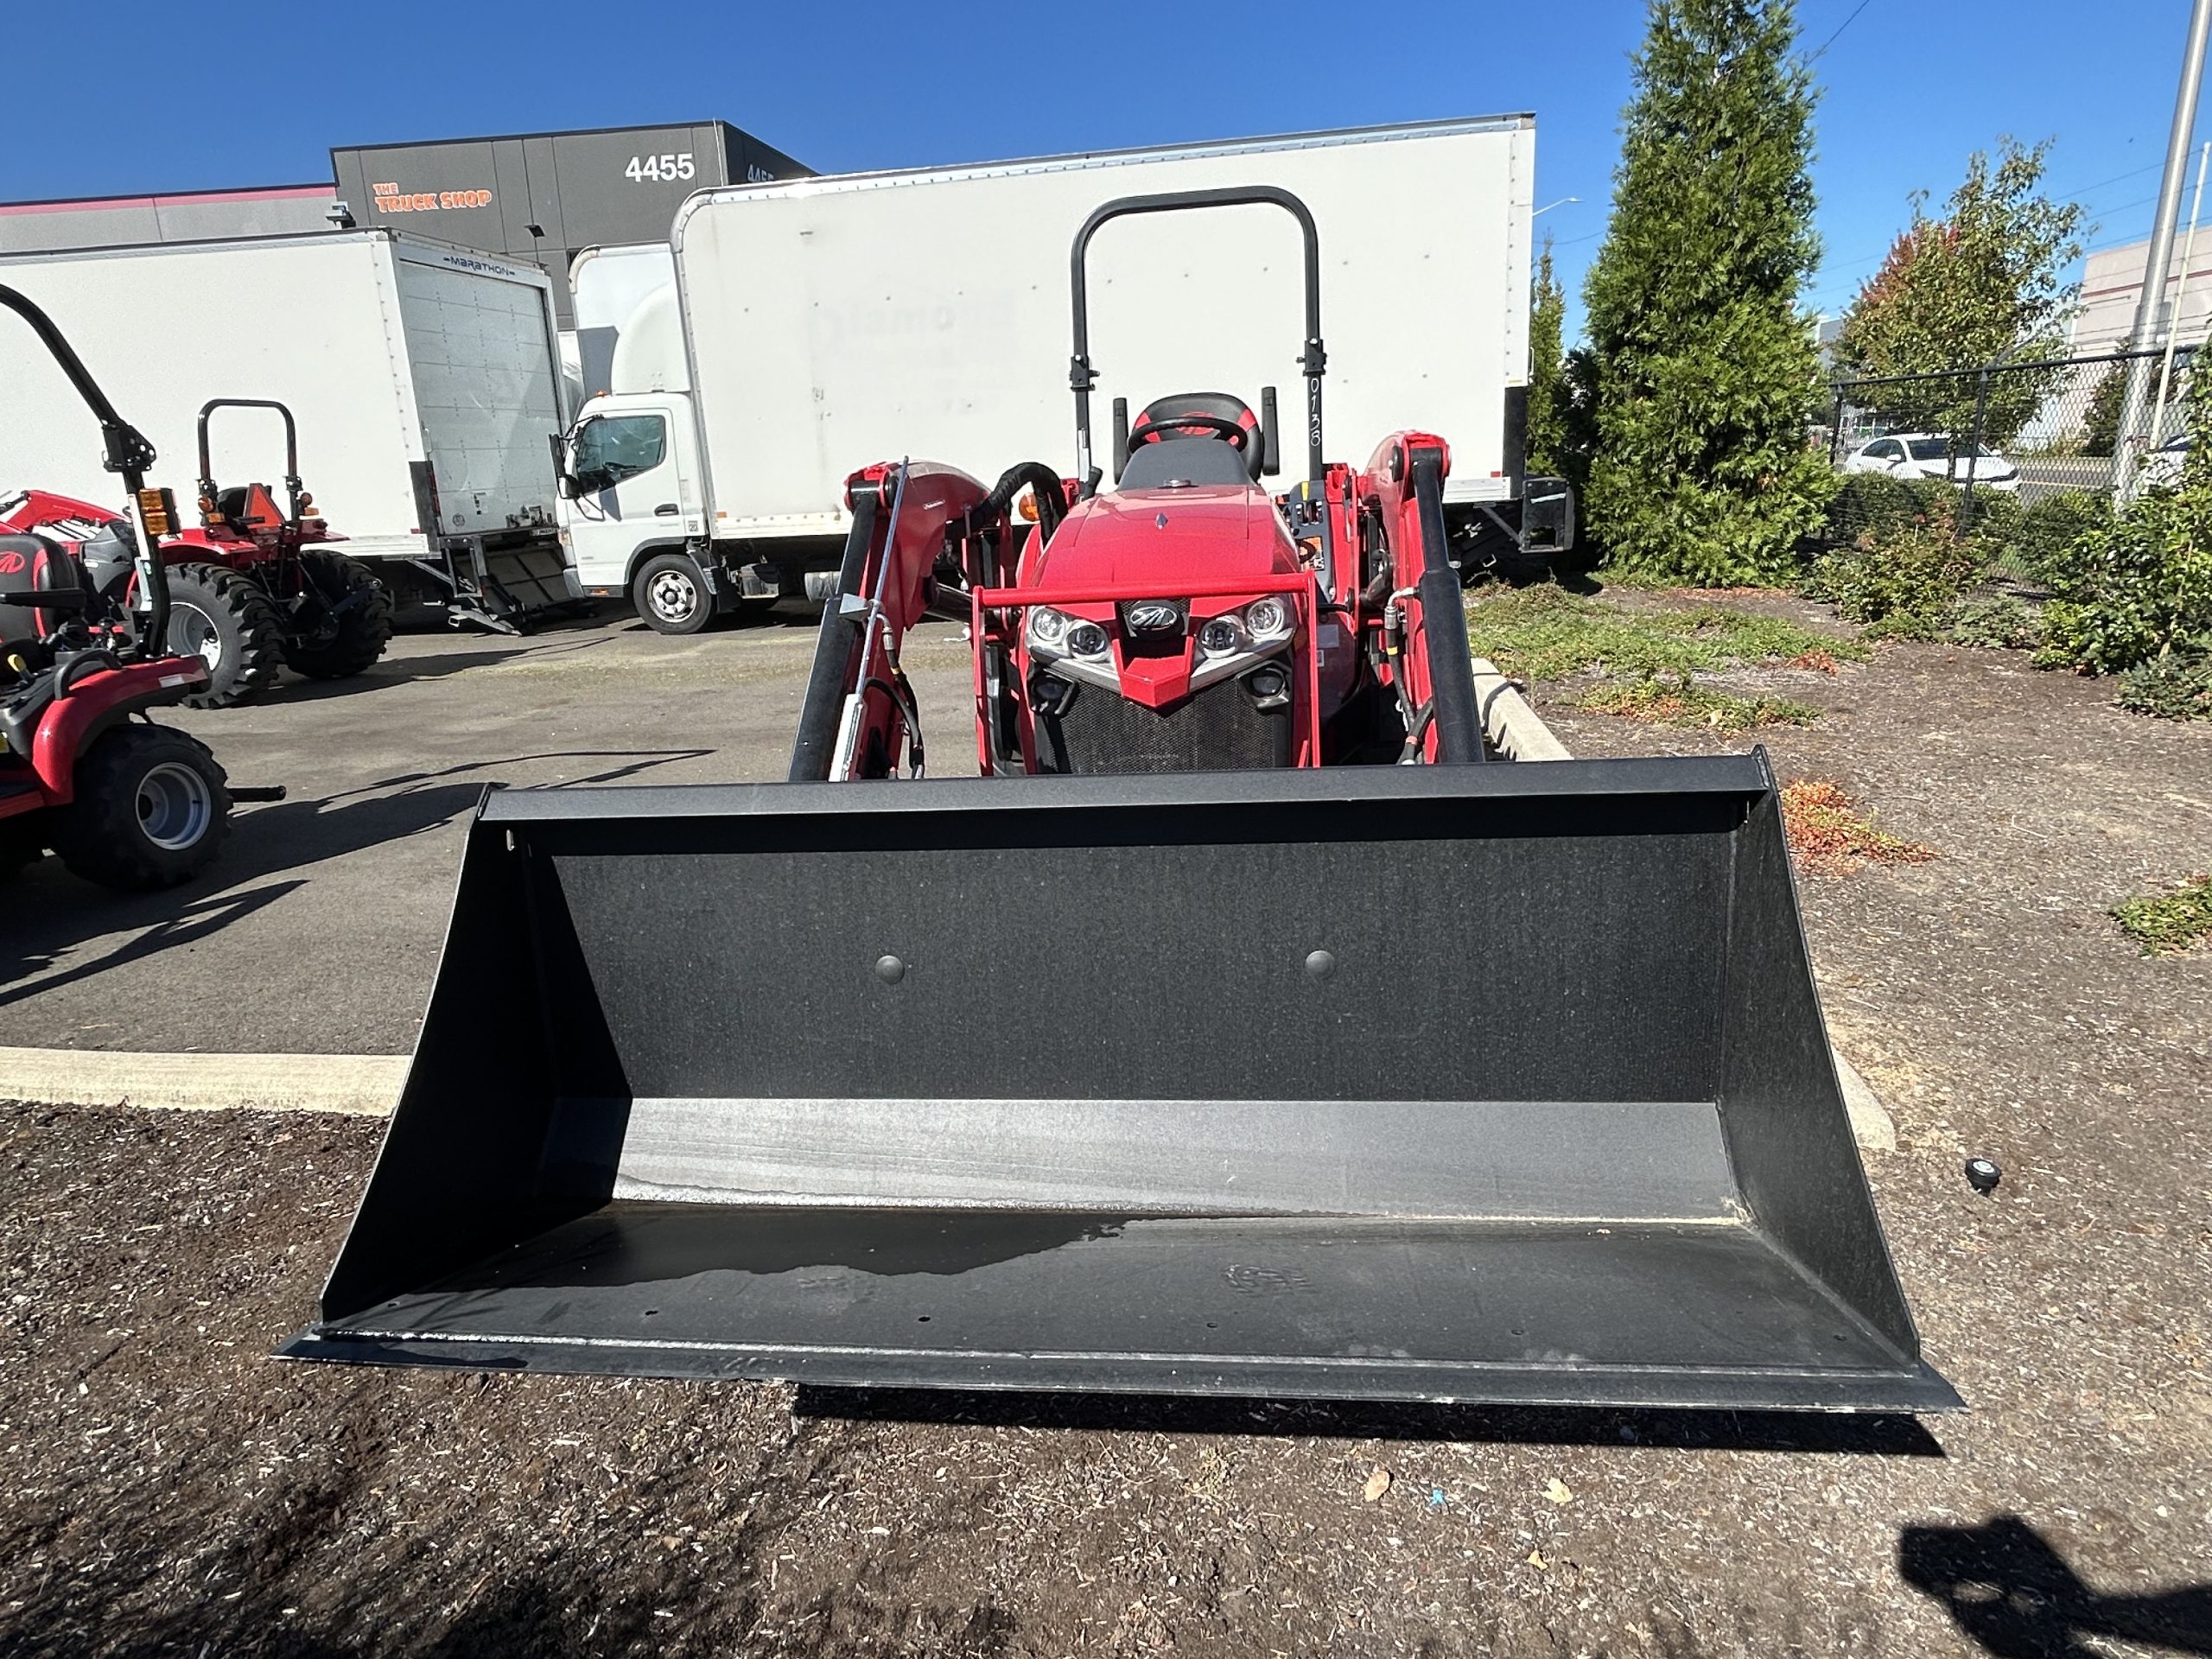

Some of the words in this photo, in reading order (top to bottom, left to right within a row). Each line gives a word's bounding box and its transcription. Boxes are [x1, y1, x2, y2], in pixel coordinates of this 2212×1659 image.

[626, 153, 696, 182] 4455
[372, 182, 399, 195] THE
[375, 194, 439, 213] TRUCK
[440, 190, 492, 209] SHOP
[1310, 378, 1321, 447] 0138
